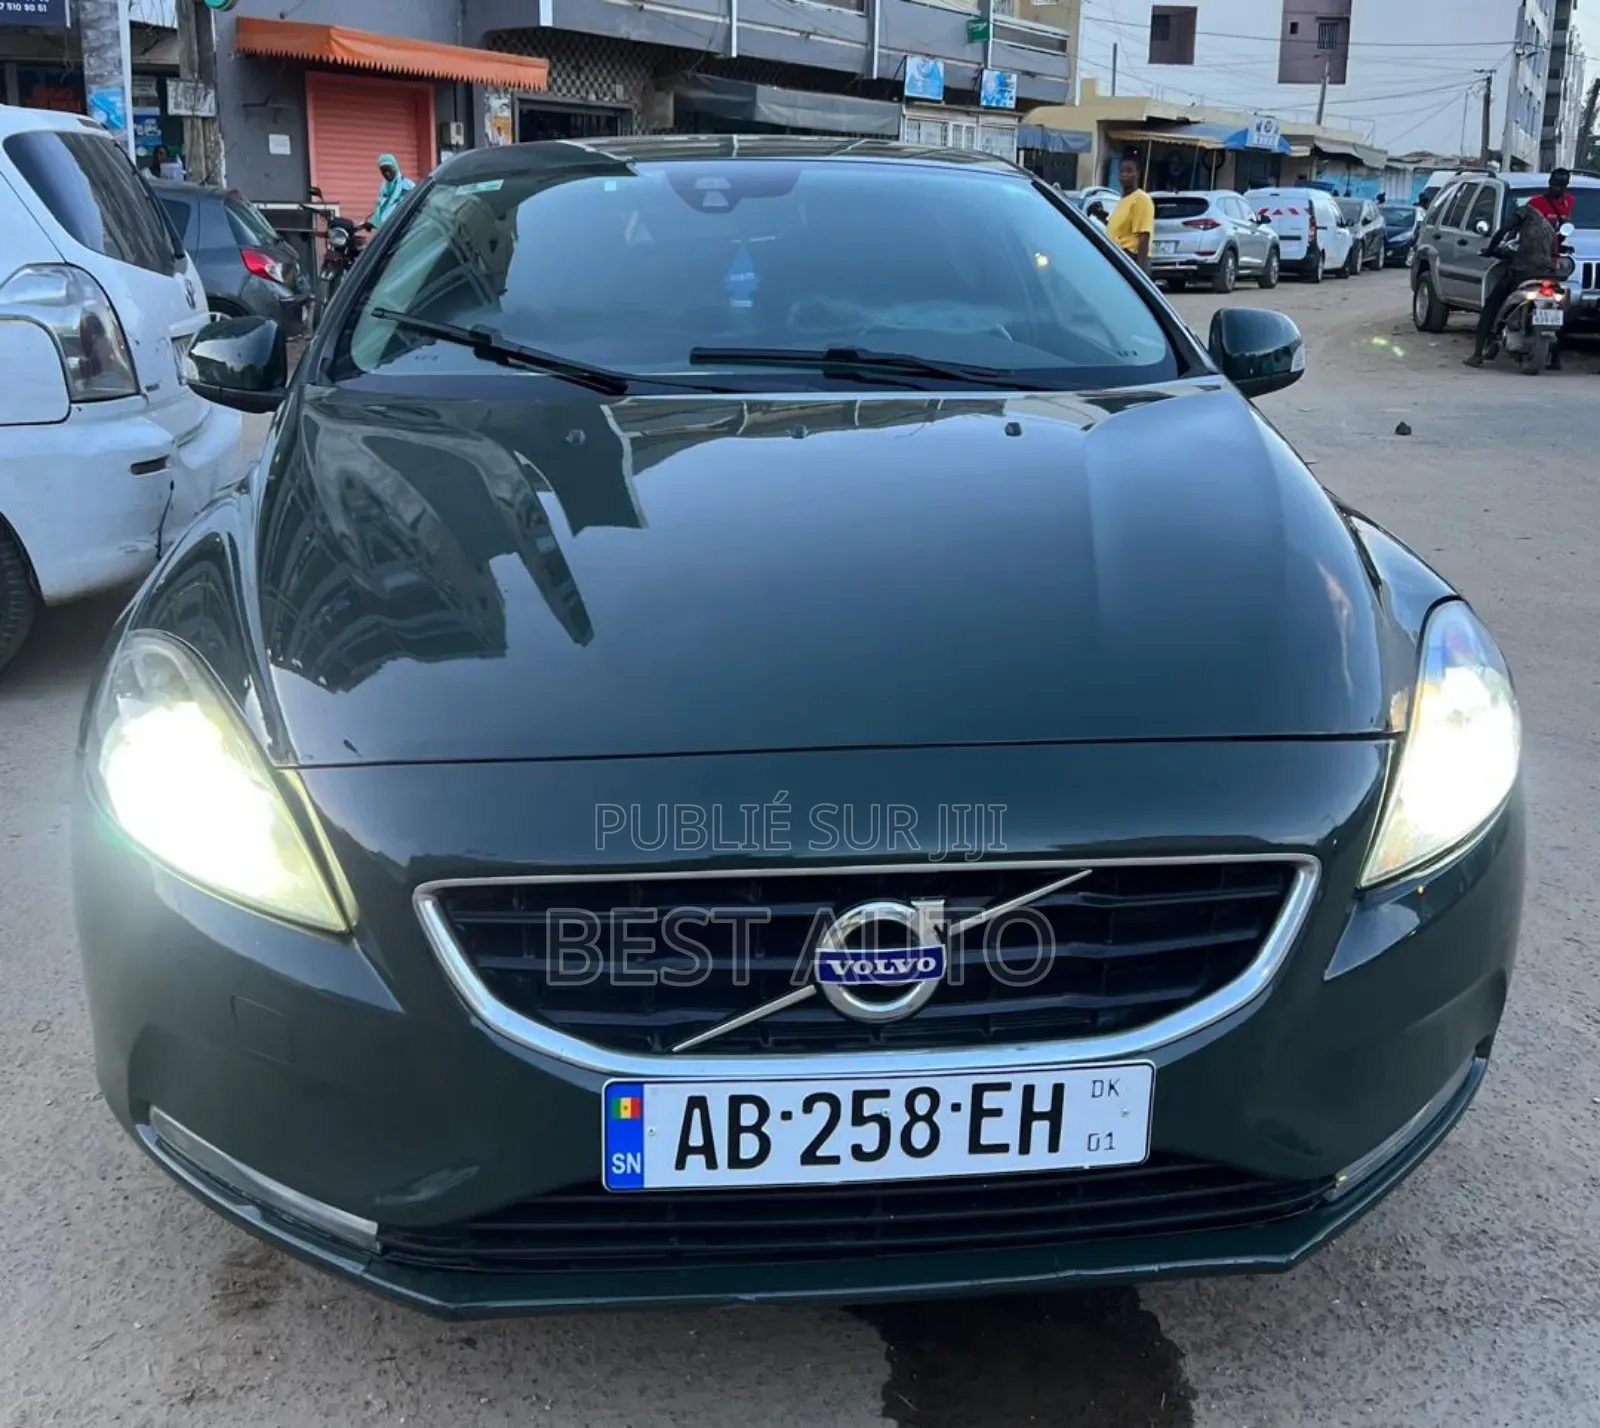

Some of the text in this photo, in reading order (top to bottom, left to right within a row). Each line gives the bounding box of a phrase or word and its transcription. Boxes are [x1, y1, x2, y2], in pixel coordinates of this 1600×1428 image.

[825, 956, 937, 976] VOLVO
[1091, 1077, 1121, 1099] DK
[1086, 1131, 1116, 1152] 01
[611, 1152, 642, 1175] SN
